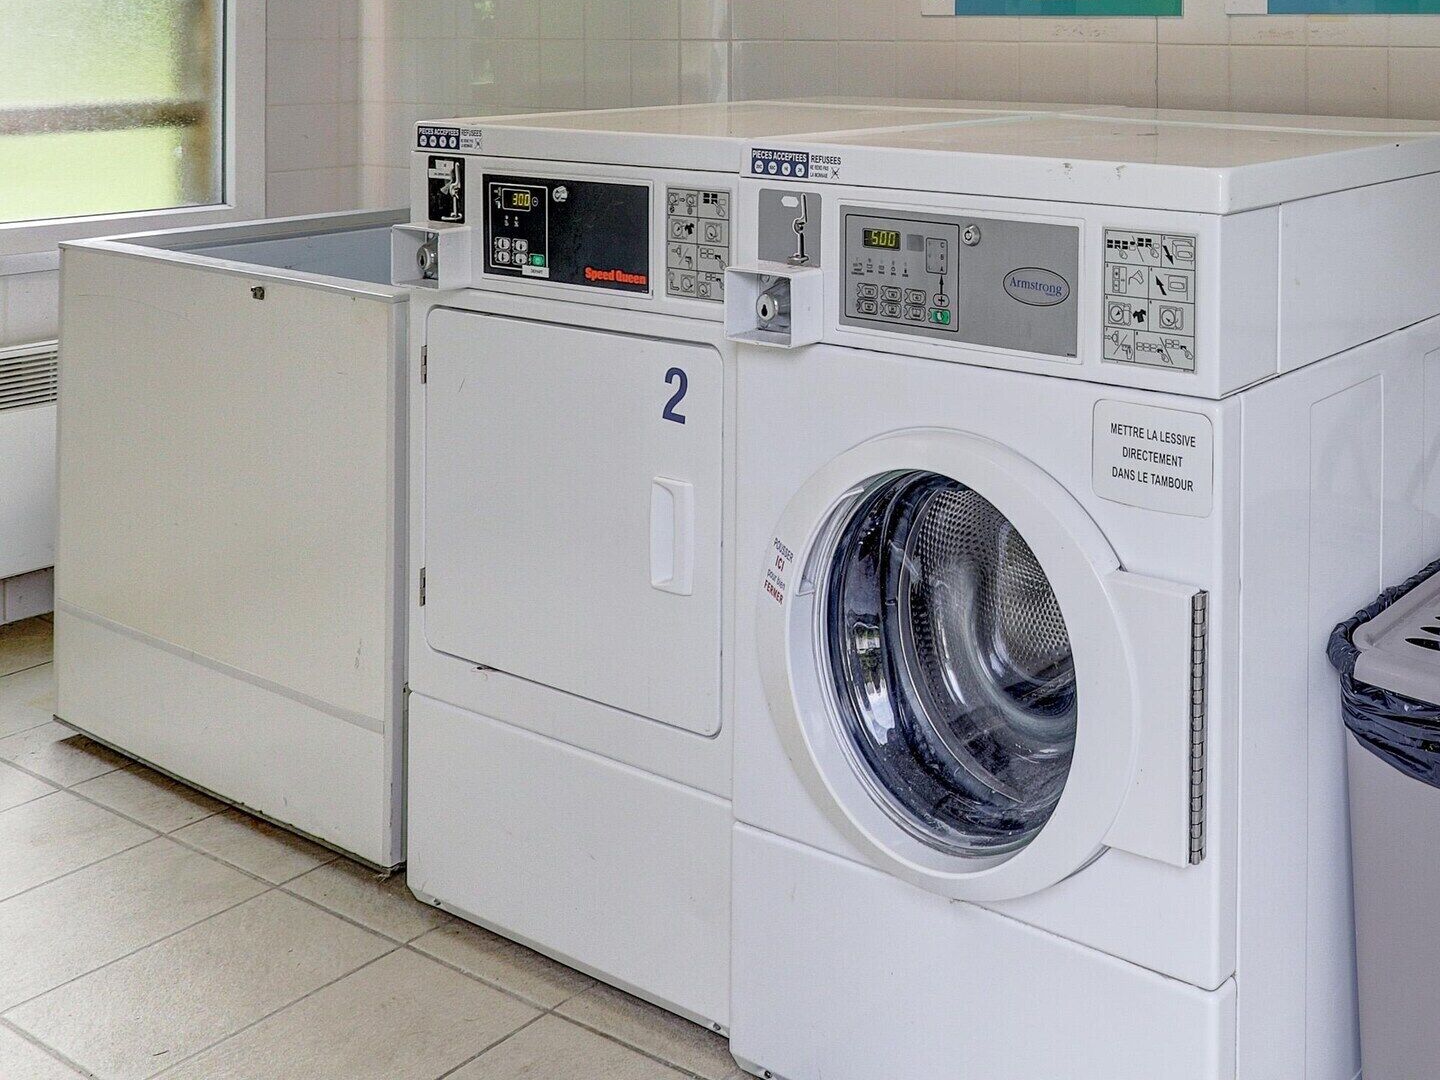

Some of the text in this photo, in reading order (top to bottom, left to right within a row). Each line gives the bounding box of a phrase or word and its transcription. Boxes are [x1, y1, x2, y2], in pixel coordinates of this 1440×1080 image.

[752, 149, 807, 163] PIECES ACCEPTEES
[810, 154, 842, 166] REFUSEES
[512, 193, 530, 207] 300
[871, 230, 896, 247] 500
[585, 267, 647, 285] Speed Queen
[1009, 276, 1062, 297] Armstrong
[662, 367, 688, 425] 2
[1110, 422, 1196, 448] METTRE LA LESSIVE
[1122, 446, 1183, 467] DIRECTEMENT
[1112, 466, 1194, 492] DANS LE TAMBOUR
[775, 555, 785, 572] ICI
[764, 579, 783, 605] FERMER
